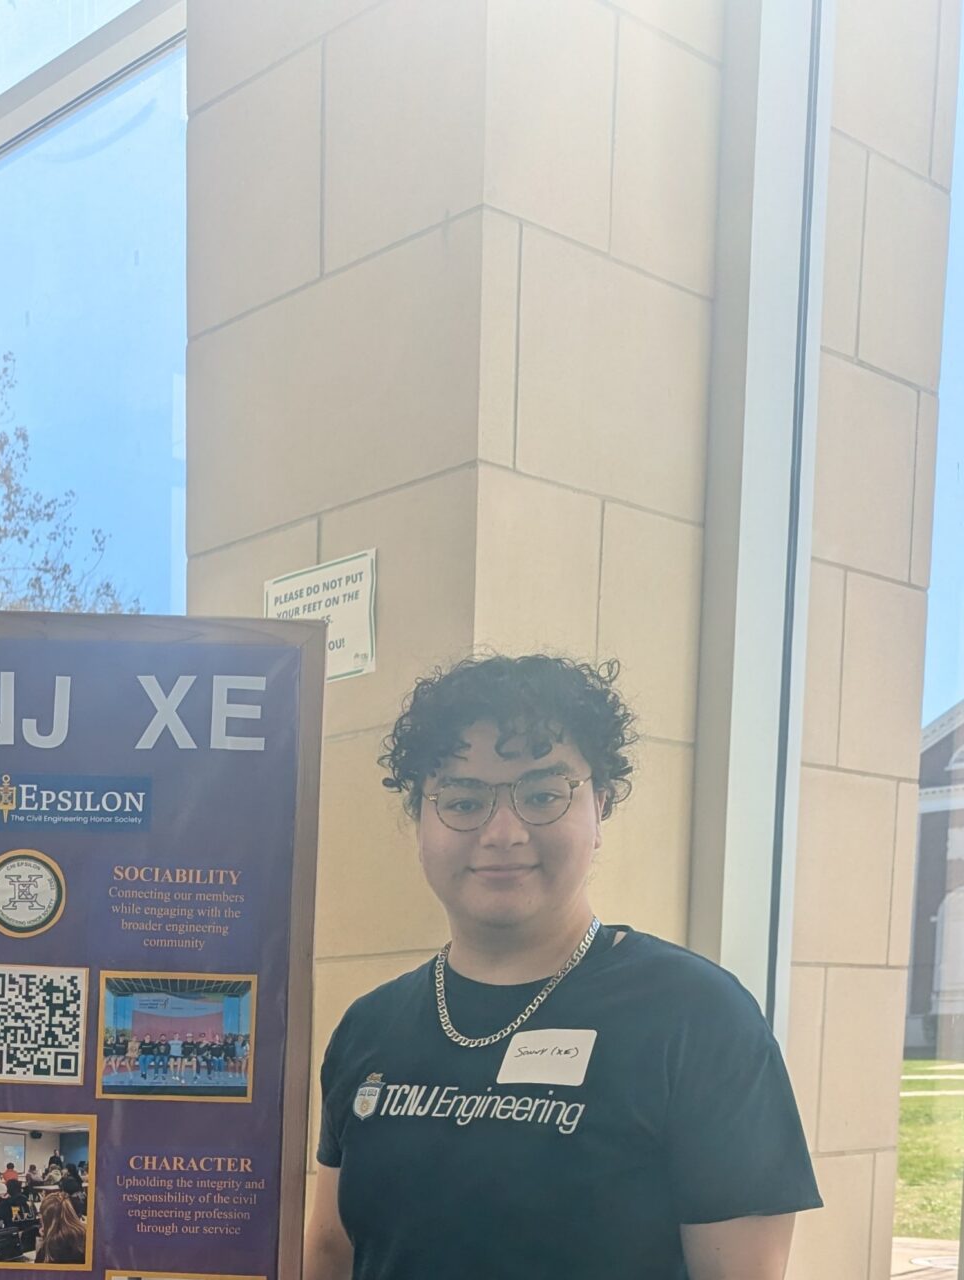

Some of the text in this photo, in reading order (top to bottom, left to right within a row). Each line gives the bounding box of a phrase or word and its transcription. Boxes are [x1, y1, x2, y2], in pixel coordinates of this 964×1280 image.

[274, 571, 364, 606] PLEASE DO NOT PUT
[276, 590, 360, 619] YOUR FEET ON THE
[328, 638, 346, 651] OU!
[134, 675, 266, 751] XE
[19, 784, 145, 812] EPSILON
[11, 814, 24, 822] The
[26, 814, 42, 822] Civil
[44, 815, 88, 824] Engineering
[114, 816, 142, 824] Society
[113, 866, 242, 885] SOCIABILITY
[108, 886, 244, 903] Connecting our members
[112, 903, 242, 919] while engaging with the
[122, 919, 229, 936] broader engineering
[143, 937, 205, 951] community
[380, 1084, 586, 1134] TCNJ Engineering
[129, 1155, 252, 1173] CHARACTER
[116, 1175, 265, 1191] Upholding the integrity and
[123, 1192, 256, 1205] responsibility of the civil
[128, 1207, 250, 1221] engineering profession
[137, 1222, 241, 1236] through our service
